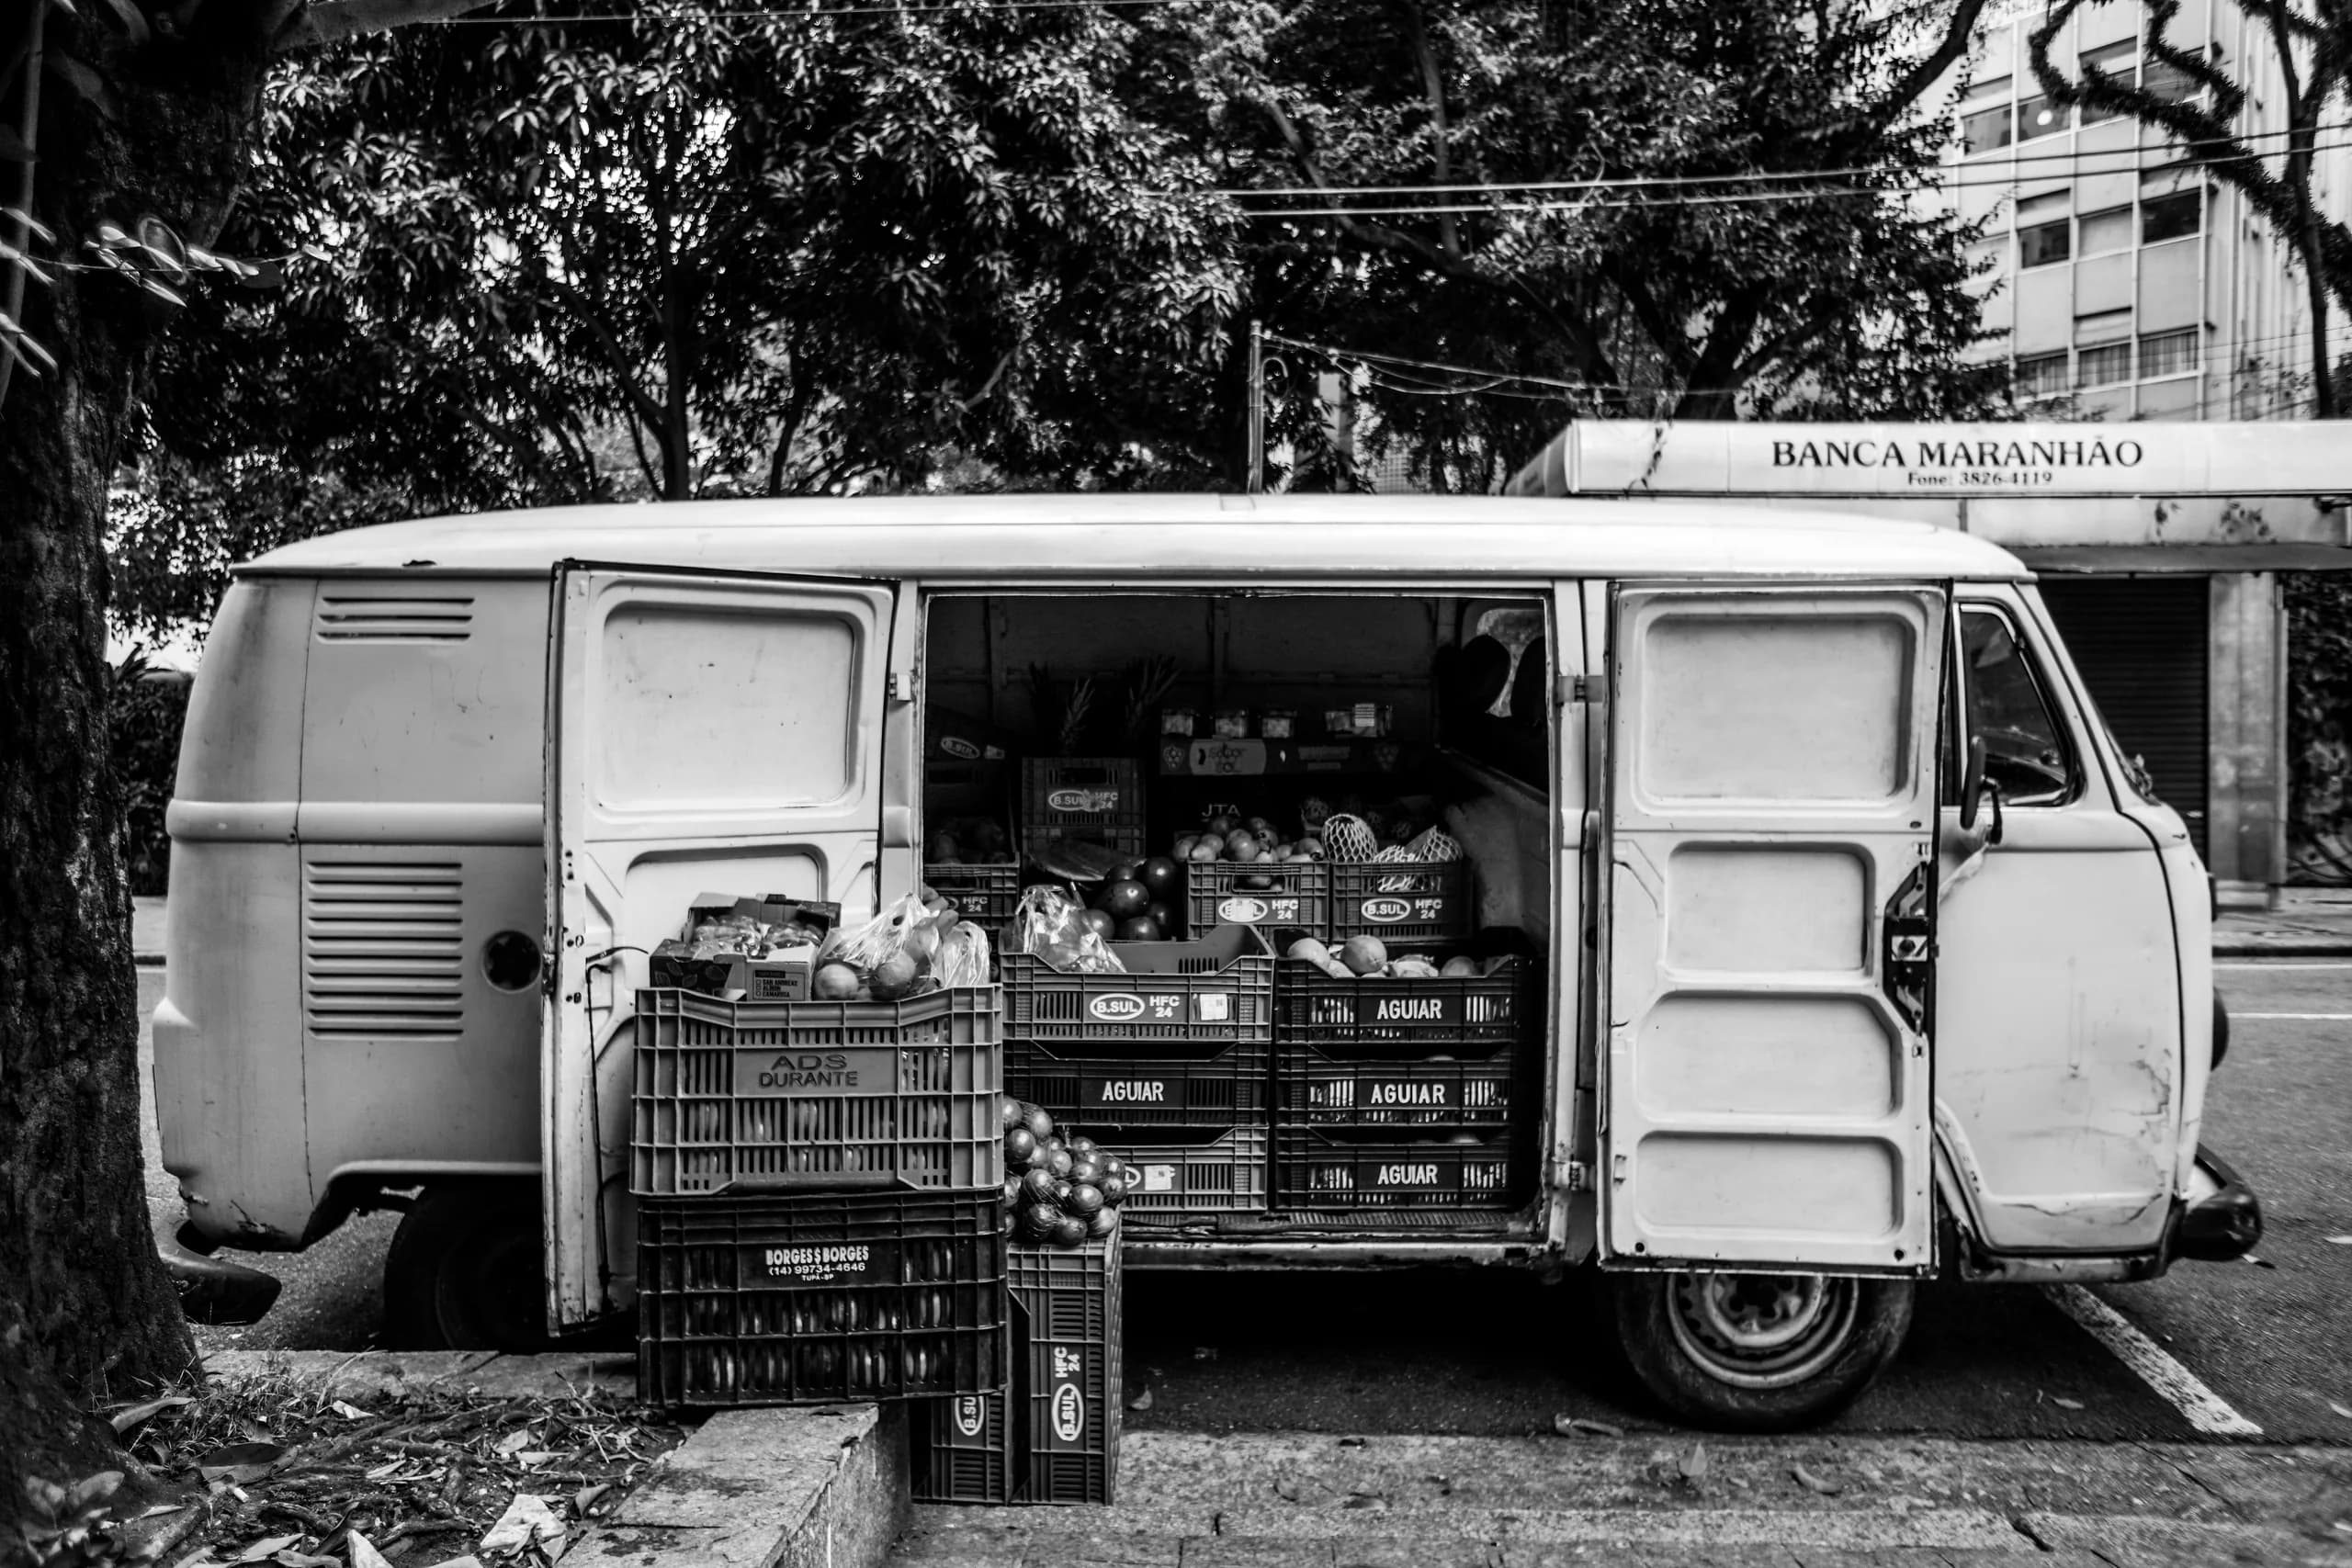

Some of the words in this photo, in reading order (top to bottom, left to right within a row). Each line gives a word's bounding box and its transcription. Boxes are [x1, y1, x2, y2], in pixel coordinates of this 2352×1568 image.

[1771, 440, 1907, 468] BANCA
[1917, 435, 2143, 468] MARANHÃO
[1959, 471, 2052, 486] 3826-4119
[962, 896, 989, 905] HFC
[967, 904, 982, 912] 24
[1271, 899, 1299, 910] HFC
[1366, 904, 1404, 916] B.SUL
[1415, 899, 1442, 910] HFC
[1277, 909, 1293, 919] 24
[1420, 909, 1436, 919] 24
[1095, 1000, 1138, 1013] B.SUL
[1149, 995, 1180, 1007] HFC
[1155, 1007, 1173, 1018] 24
[1377, 998, 1442, 1020] AGUIAR
[770, 1054, 847, 1071] ADS
[759, 1071, 859, 1088] DURANTE
[1102, 1080, 1164, 1101] AGUIAR
[1371, 1083, 1446, 1104] AGUIAR
[1377, 1164, 1439, 1185] AGUIAR
[768, 1266, 792, 1276] (14)
[794, 1262, 866, 1275] 99734-4646
[1054, 1347, 1069, 1378] HFC
[1068, 1353, 1080, 1372] 24
[963, 1396, 977, 1429] B.SU
[1061, 1391, 1076, 1435] B.SUL
